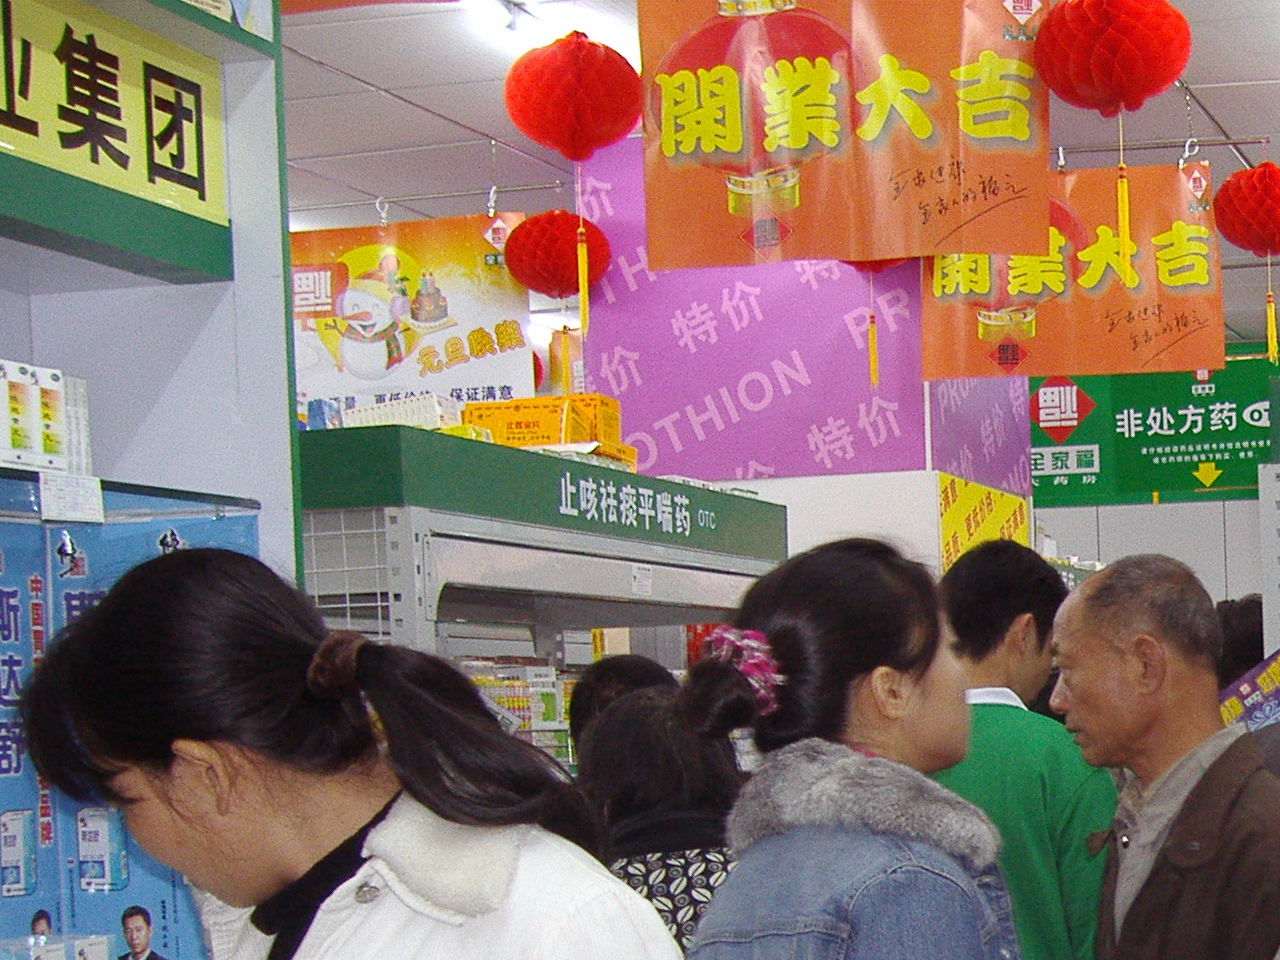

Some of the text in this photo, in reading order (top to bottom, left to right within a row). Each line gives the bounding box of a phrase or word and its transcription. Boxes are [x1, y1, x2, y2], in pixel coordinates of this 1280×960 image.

[655, 51, 1034, 156] 開業大吉
[671, 280, 765, 353] 特价
[807, 396, 902, 469] 特价
[1115, 402, 1238, 438] 非处方药
[559, 471, 716, 537] 止咳祛痰平喘药 OTC
